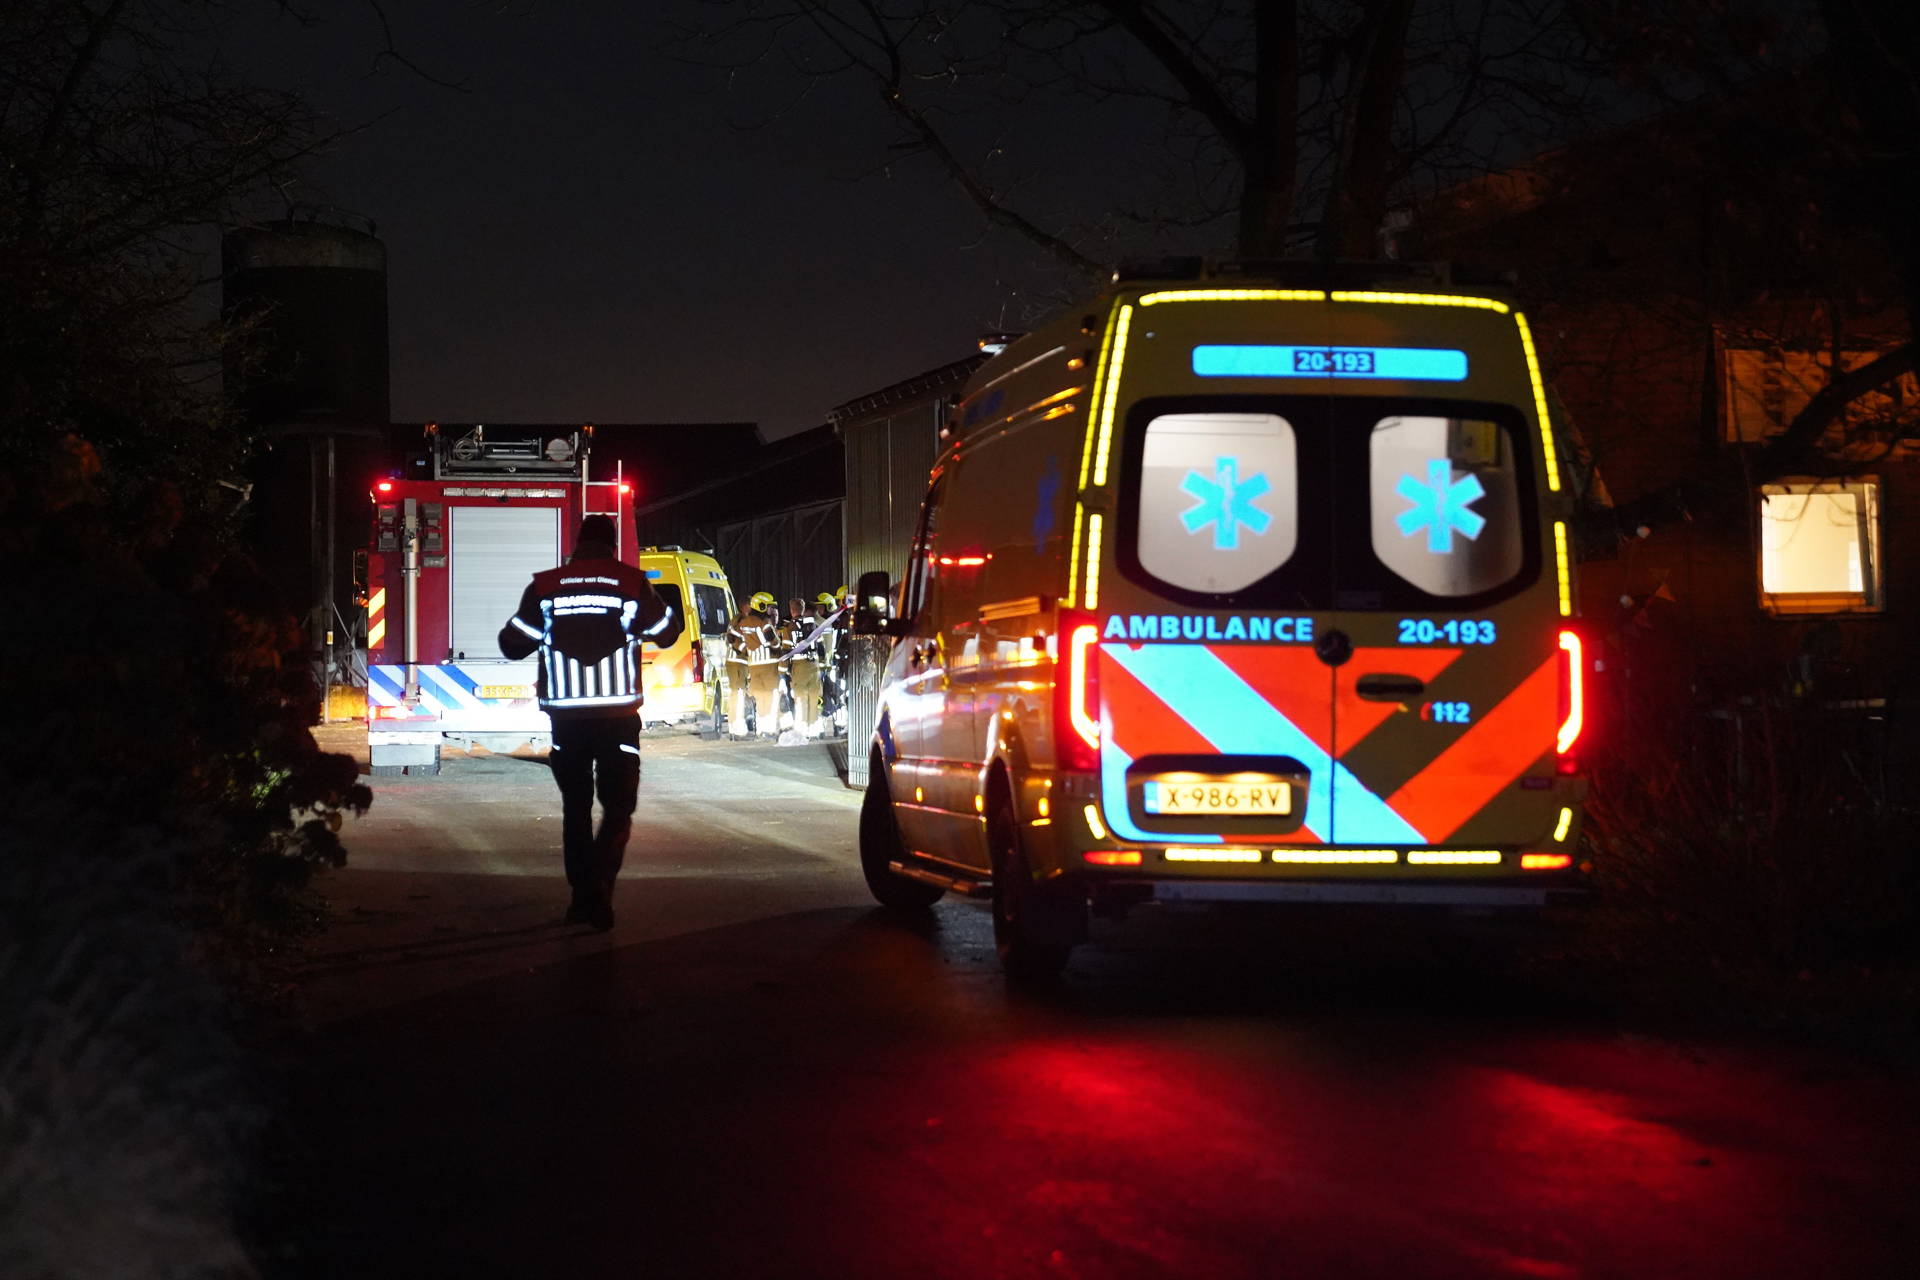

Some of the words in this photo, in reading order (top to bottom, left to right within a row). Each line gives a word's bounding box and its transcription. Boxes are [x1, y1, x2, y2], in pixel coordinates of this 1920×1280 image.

[1297, 352, 1371, 371] 20-193
[1103, 614, 1313, 641] AMBULANCE
[1398, 619, 1496, 645] 20-193
[1431, 702, 1470, 723] 112
[1167, 788, 1281, 809] X-986-RV
